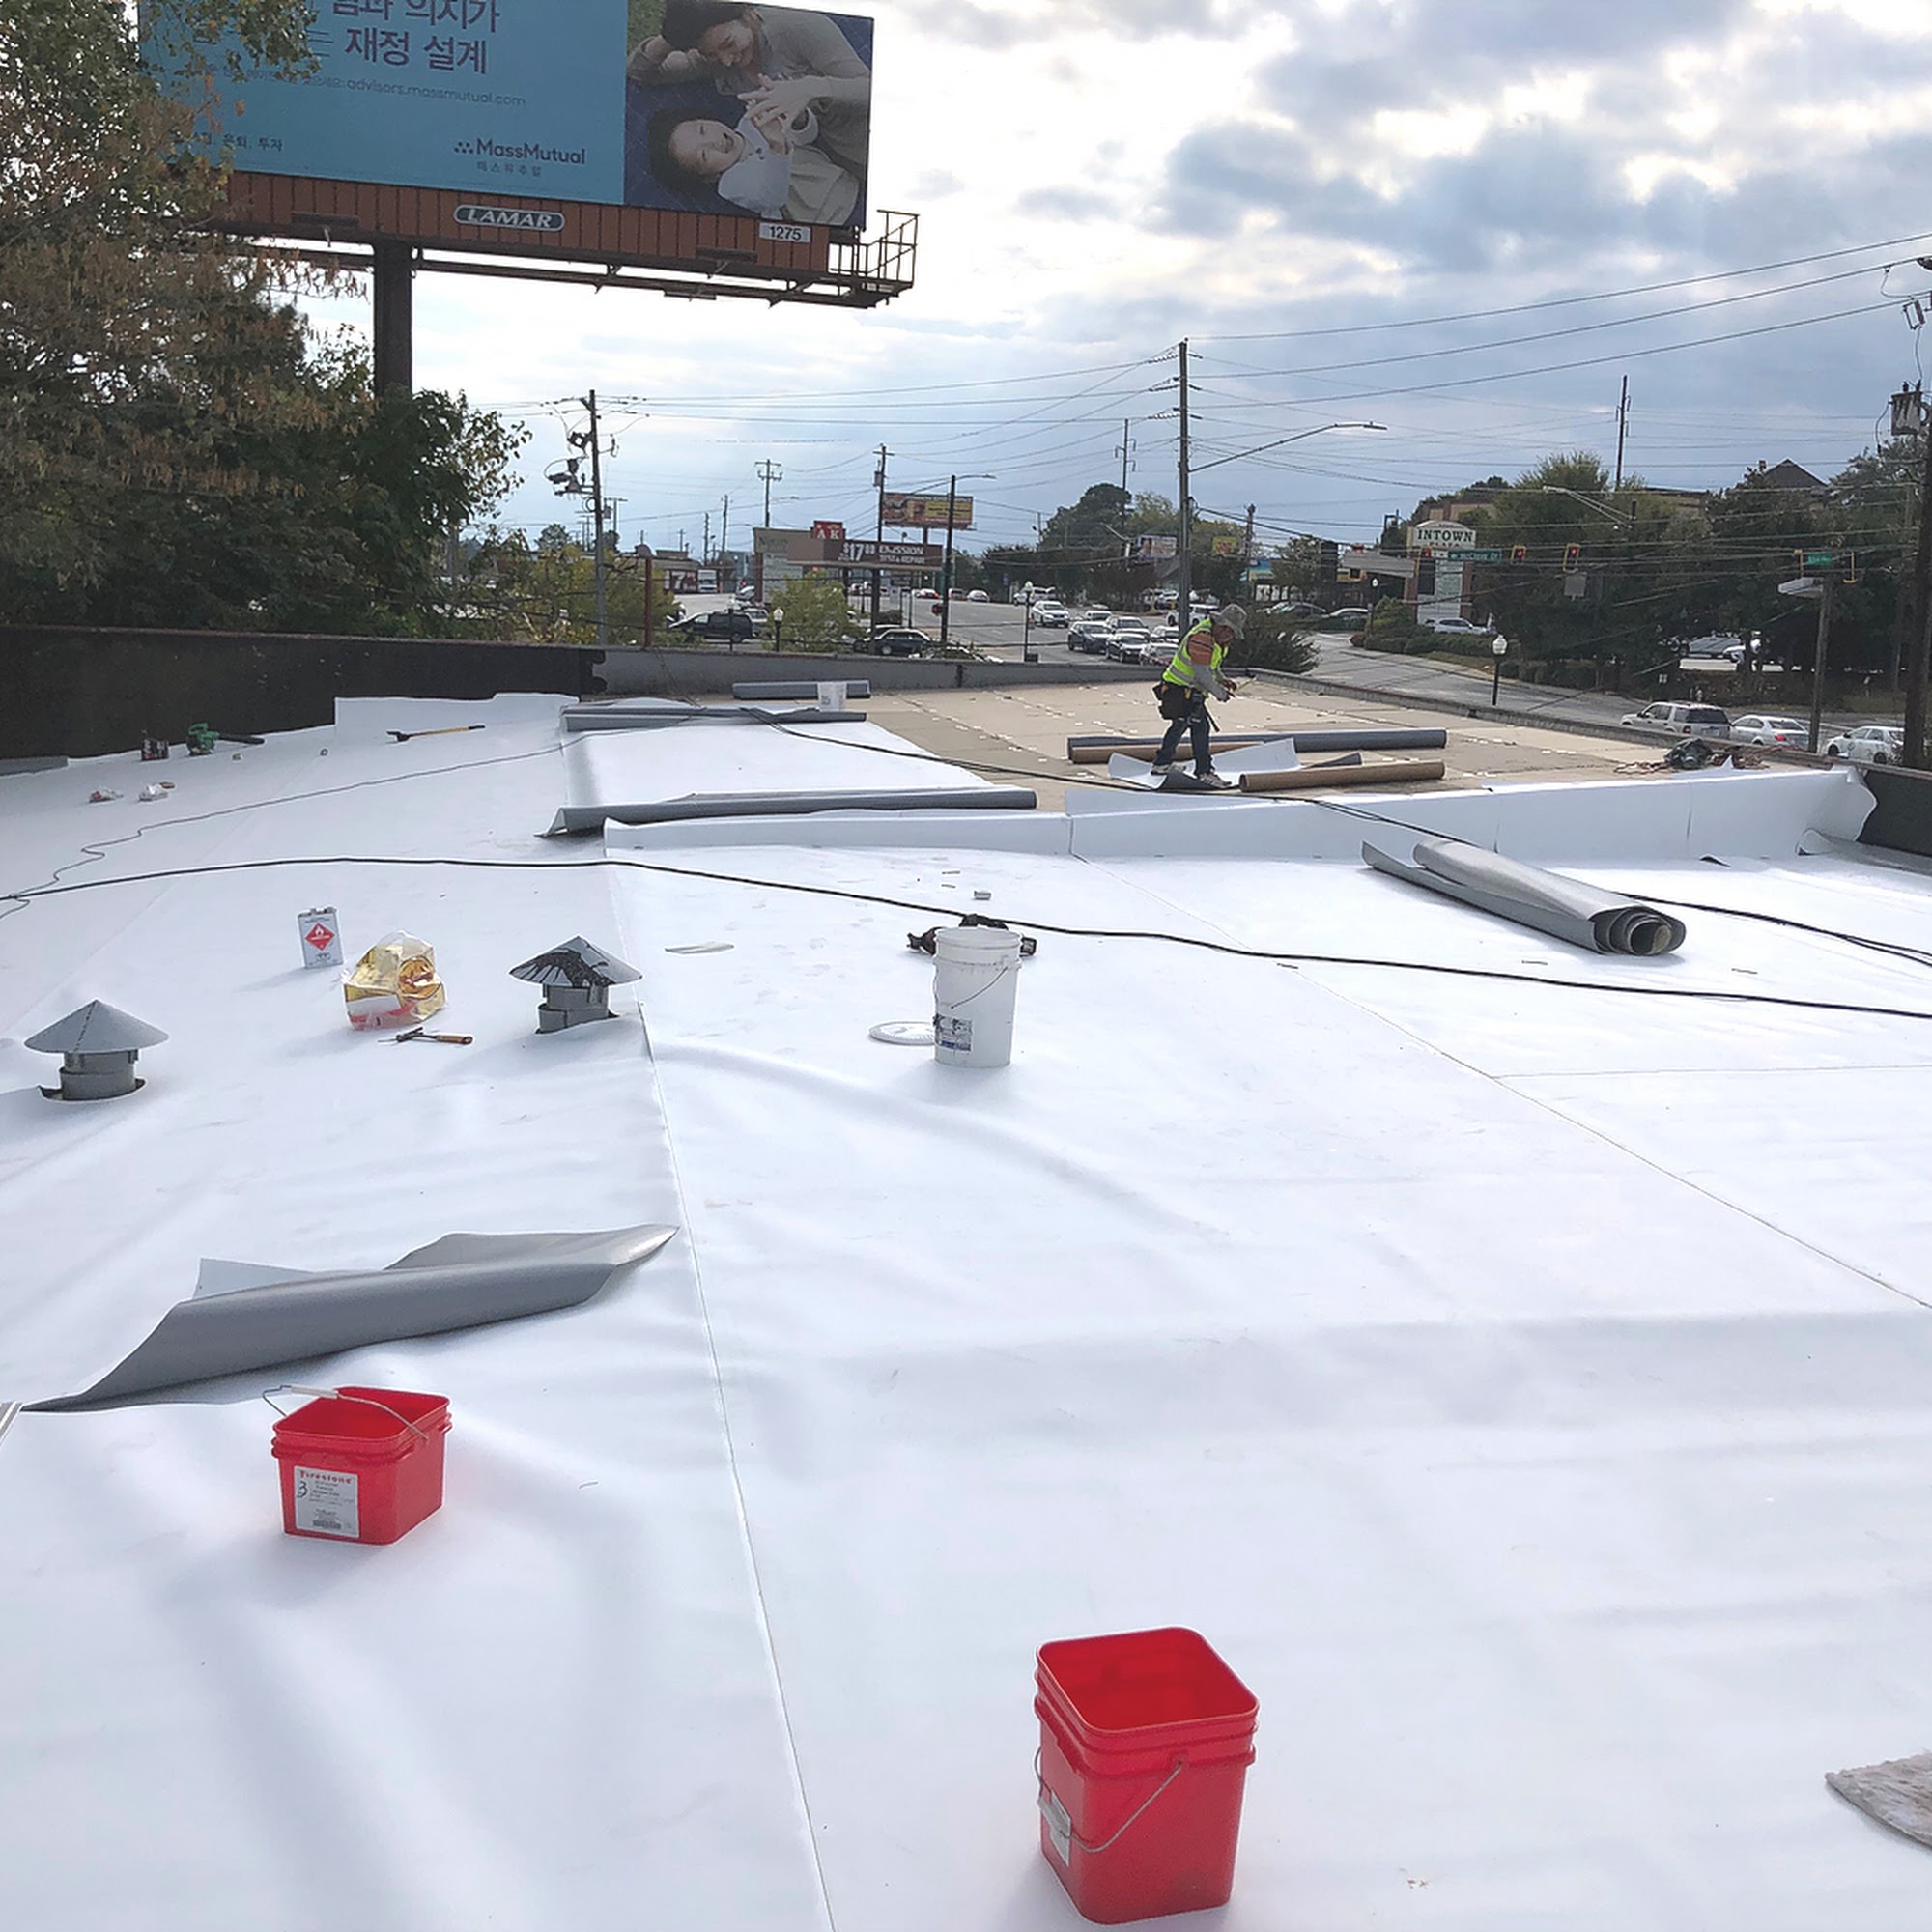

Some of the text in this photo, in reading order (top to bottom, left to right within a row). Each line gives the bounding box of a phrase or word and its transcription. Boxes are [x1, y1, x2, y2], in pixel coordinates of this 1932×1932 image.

[345, 27, 487, 74] 재정 설계
[346, 77, 526, 107] advisors.massmutual.com
[476, 138, 585, 164] MassMutual
[467, 209, 553, 228] LAMAR
[769, 226, 802, 241] 1275
[1417, 530, 1473, 542] INTOWN
